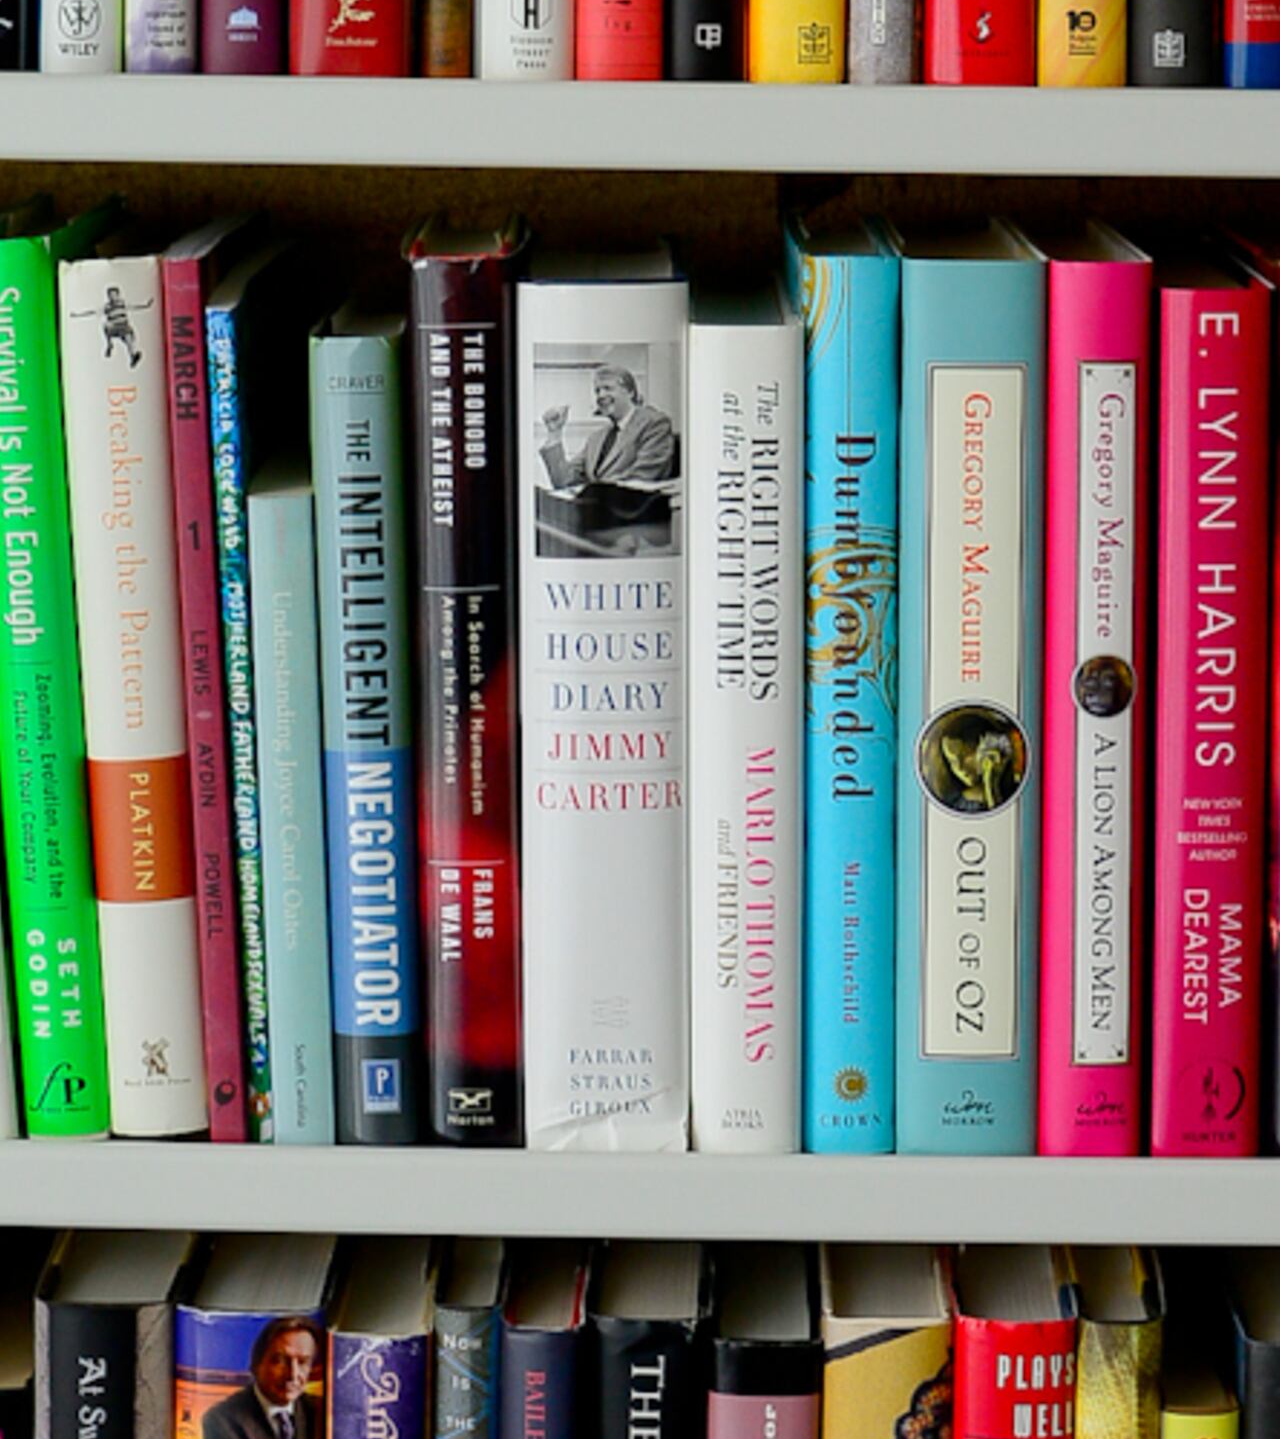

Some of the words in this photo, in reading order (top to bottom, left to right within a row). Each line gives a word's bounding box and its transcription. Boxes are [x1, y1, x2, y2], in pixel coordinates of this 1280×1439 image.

[1195, 311, 1240, 362] E.
[345, 419, 372, 462] THE
[1195, 387, 1240, 531] LYNN
[337, 472, 392, 747] INTELLIGENT
[545, 583, 675, 612] WHITE
[547, 631, 672, 662] HOUSE
[1192, 562, 1239, 770] HARRIS
[551, 683, 668, 712] DIARY
[548, 733, 672, 762] JIMMY
[536, 781, 682, 811] CARTER
[128, 772, 156, 892] PLATKIN
[345, 762, 401, 1030] NEGOTIATOR
